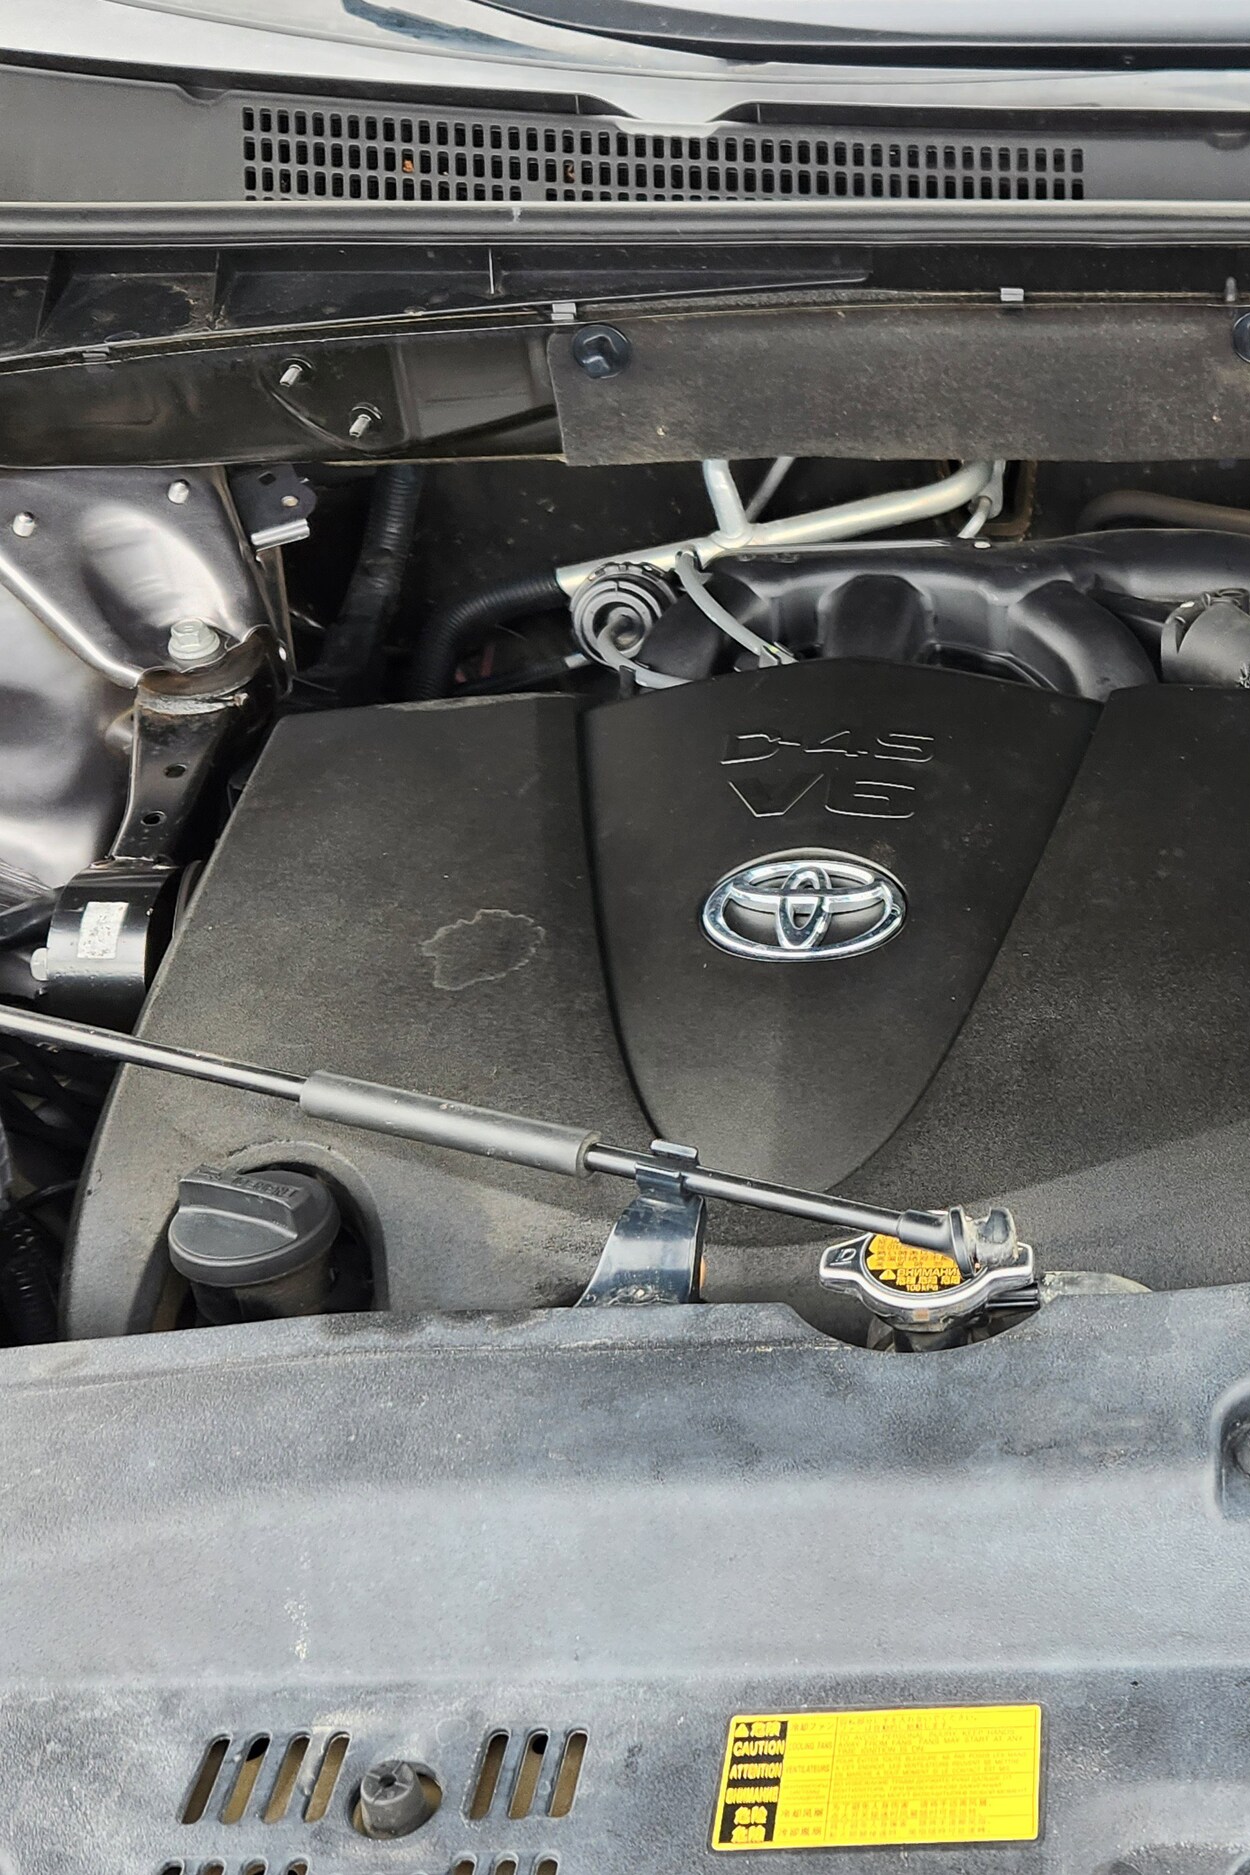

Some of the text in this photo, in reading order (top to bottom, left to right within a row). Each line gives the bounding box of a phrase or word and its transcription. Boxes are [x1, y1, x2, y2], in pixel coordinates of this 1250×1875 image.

[728, 774, 916, 819] V6
[733, 1739, 786, 1756] CAUTION
[729, 1762, 784, 1780] ATTENTION
